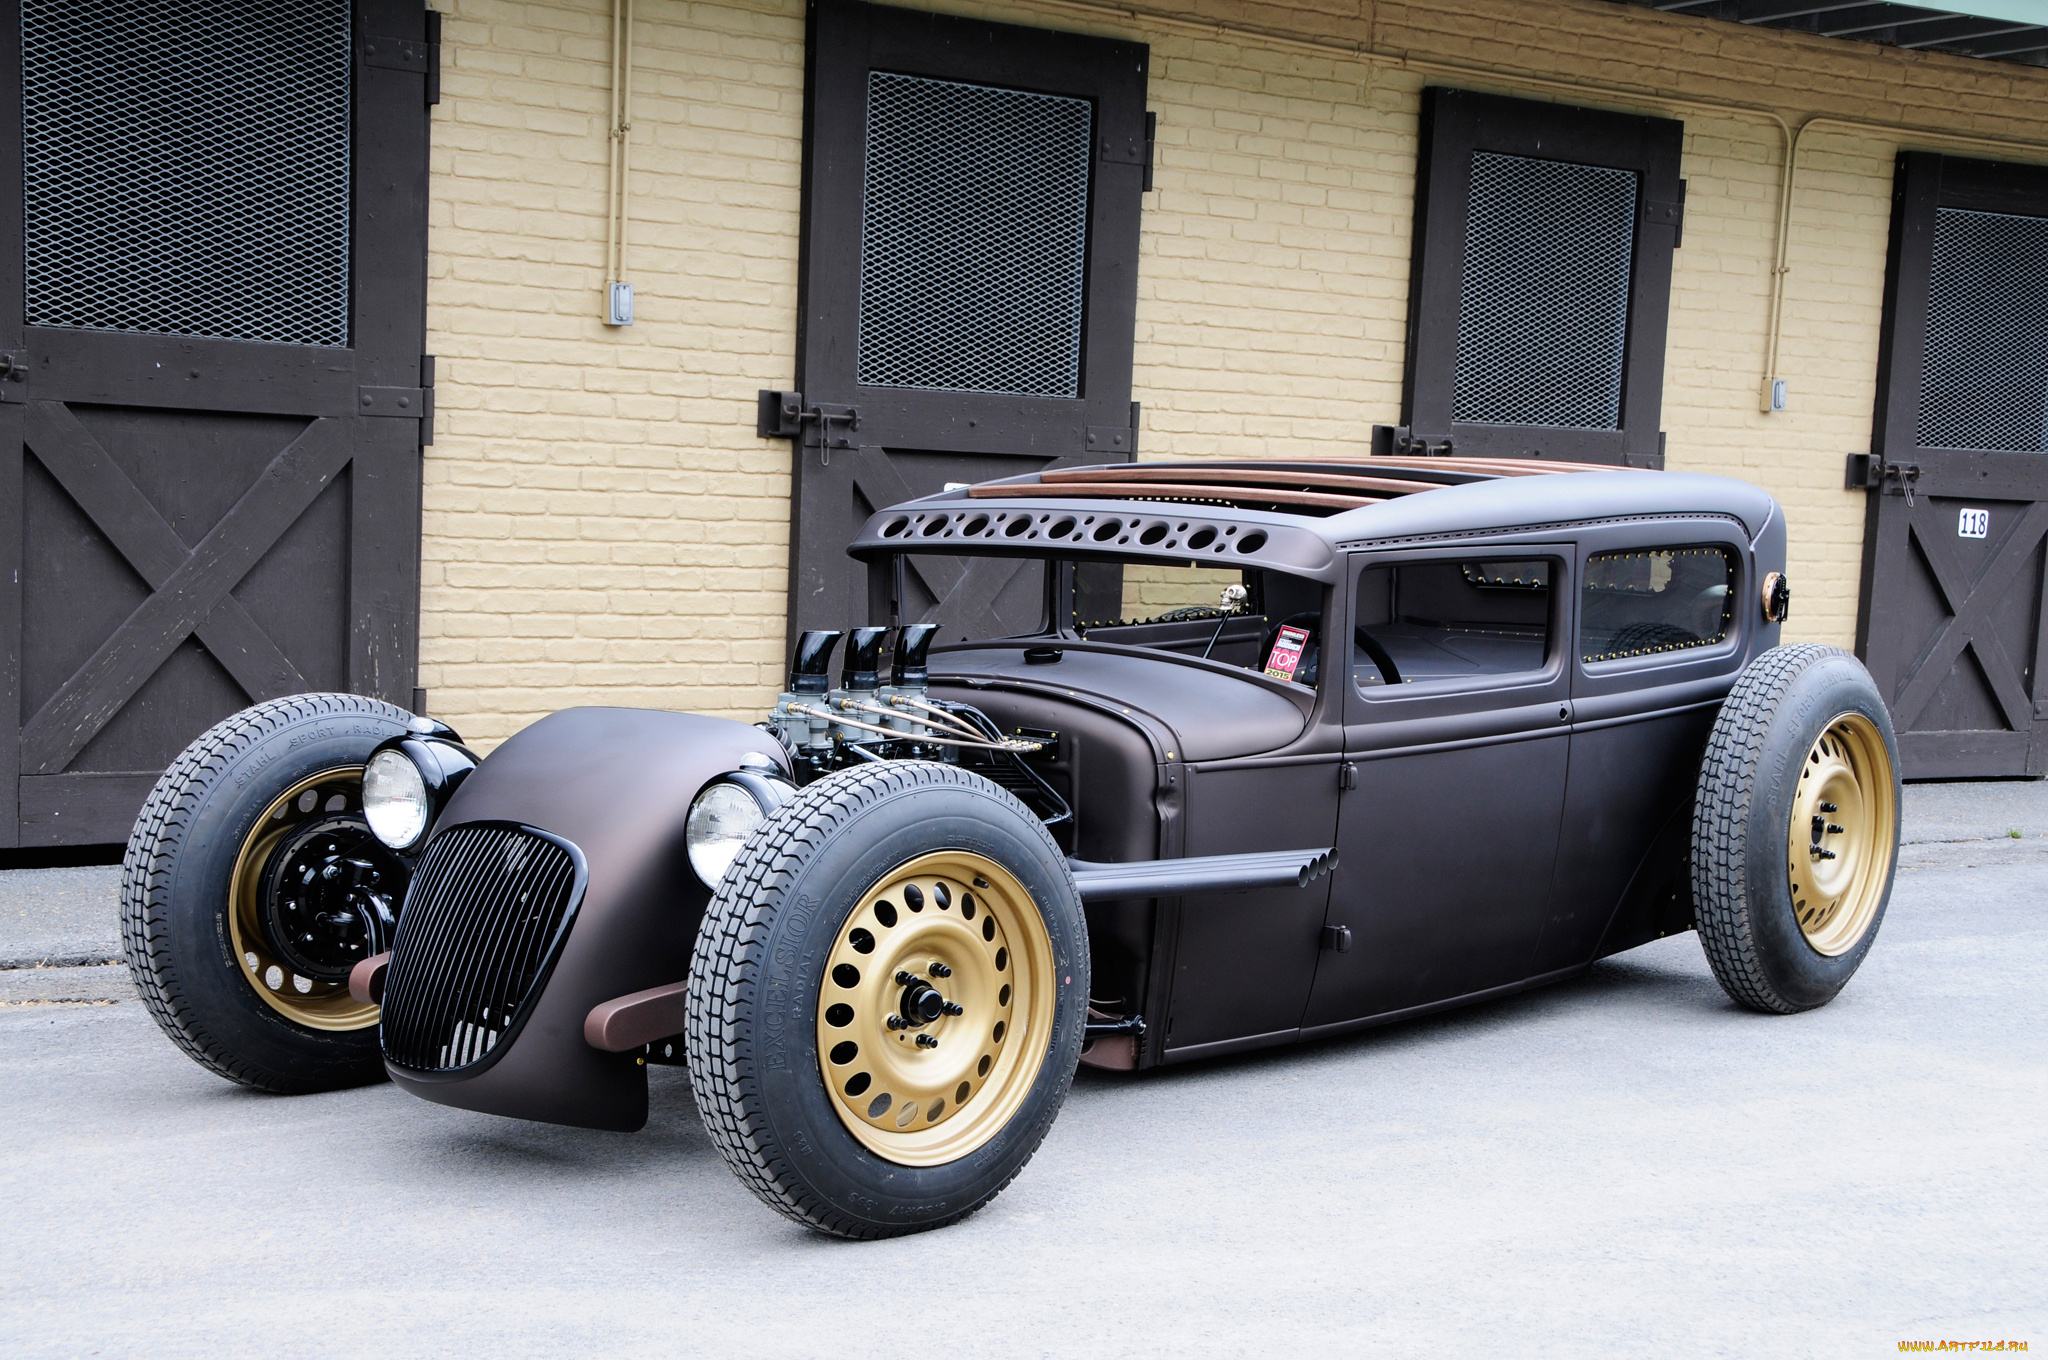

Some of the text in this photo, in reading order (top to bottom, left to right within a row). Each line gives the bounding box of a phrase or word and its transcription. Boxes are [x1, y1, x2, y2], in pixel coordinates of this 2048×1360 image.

[1961, 512, 1986, 535] 118
[1266, 669, 1290, 679] 2015
[1272, 650, 1297, 668] TOP
[234, 752, 276, 787] STAHL
[290, 727, 334, 747] SPORT
[764, 893, 820, 1073] EXCELSIOR
[791, 950, 814, 1020] RADIAL
